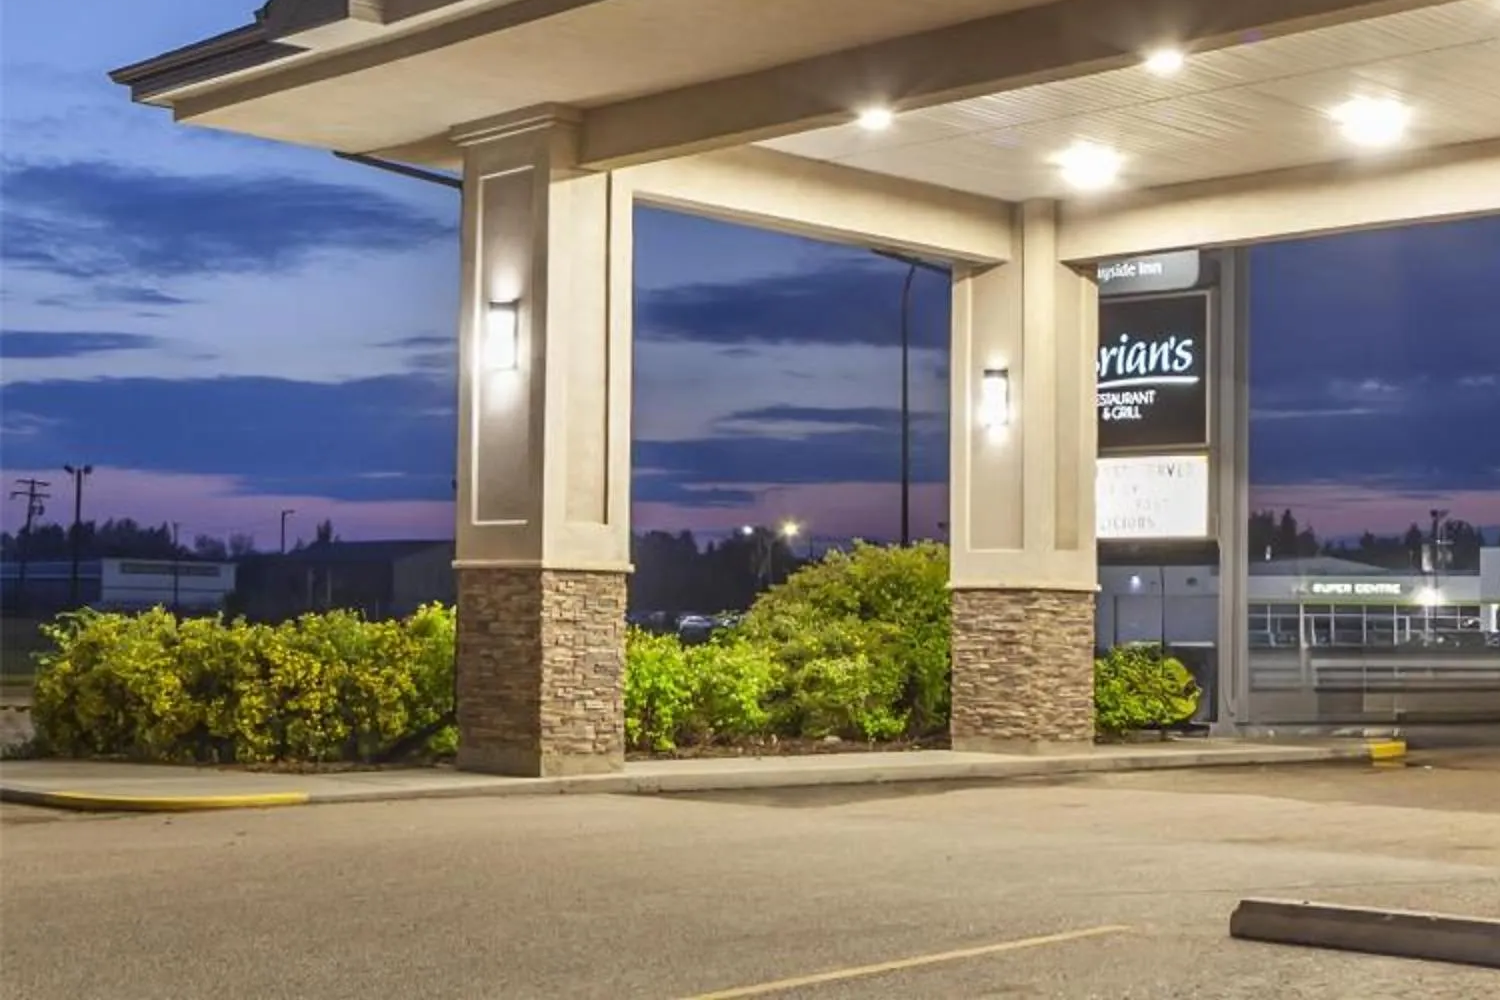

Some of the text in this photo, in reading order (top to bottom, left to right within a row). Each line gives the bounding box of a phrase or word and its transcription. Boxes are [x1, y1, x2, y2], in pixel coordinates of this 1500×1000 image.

[1137, 261, 1163, 276] Inn
[1096, 333, 1194, 377] rian's
[1111, 405, 1143, 420] GRILL
